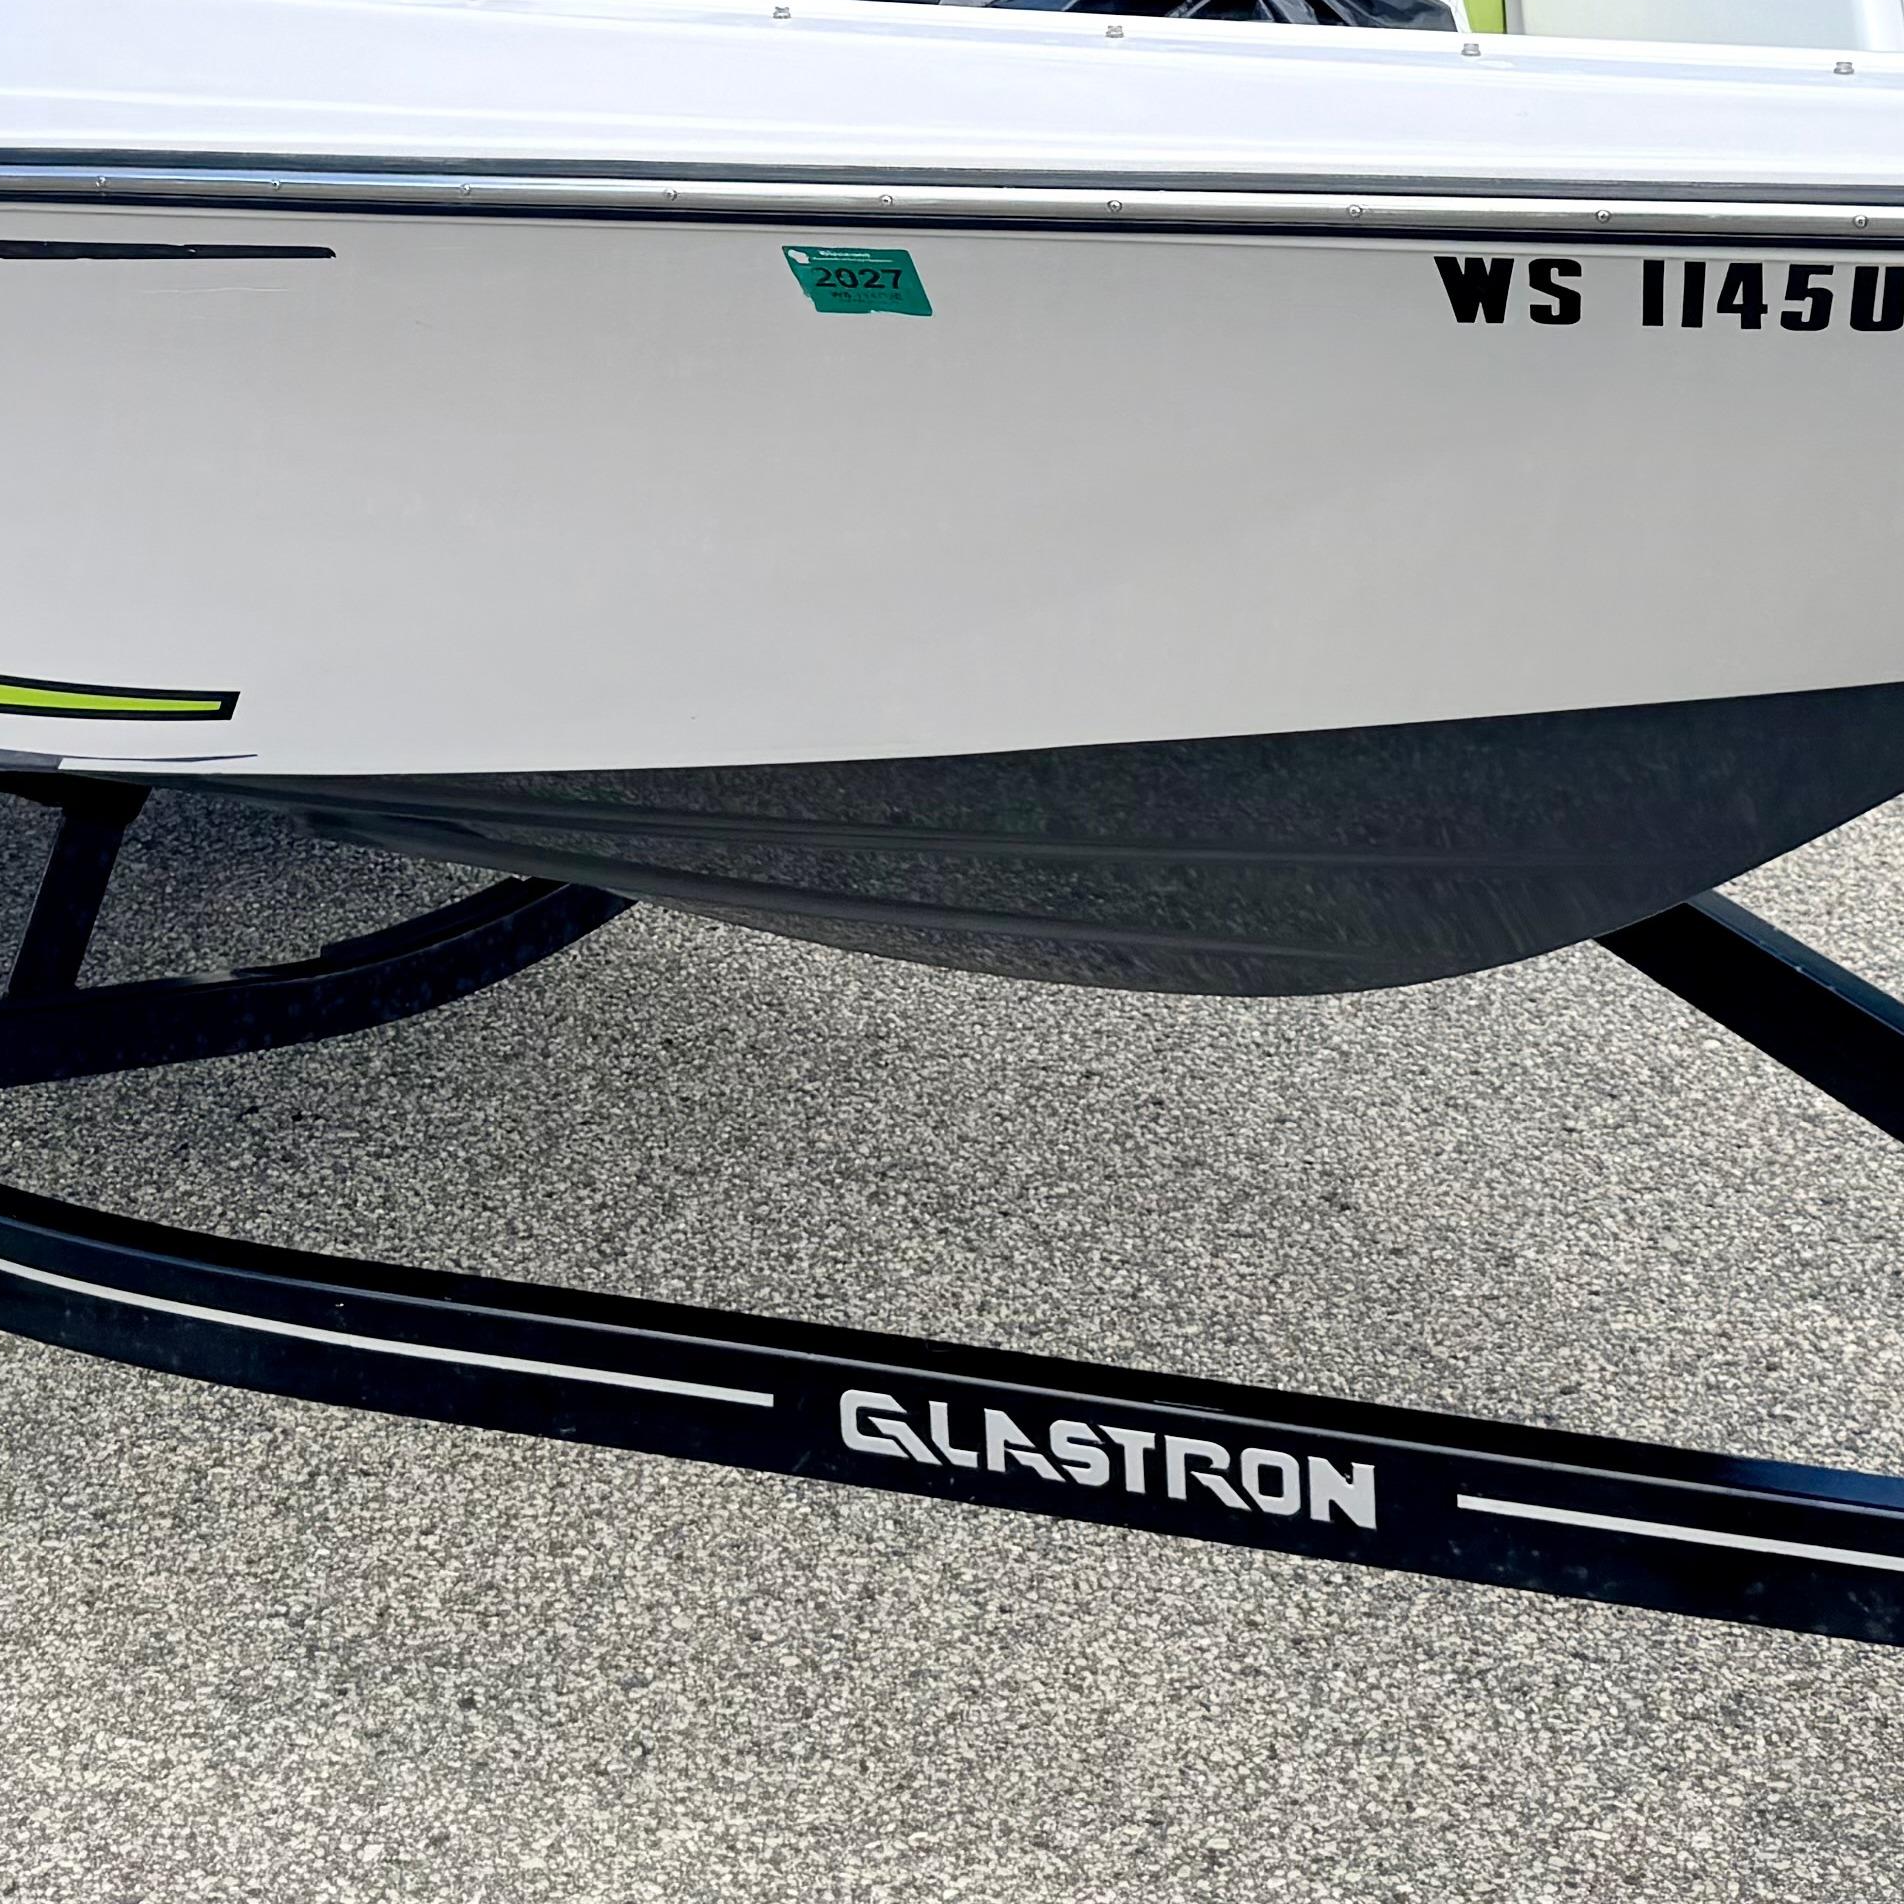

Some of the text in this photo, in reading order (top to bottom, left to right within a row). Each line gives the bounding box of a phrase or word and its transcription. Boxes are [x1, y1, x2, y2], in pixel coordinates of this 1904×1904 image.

[811, 266, 903, 289] 2027
[1433, 255, 1583, 326] WS
[839, 1388, 1378, 1530] GLASTRON
